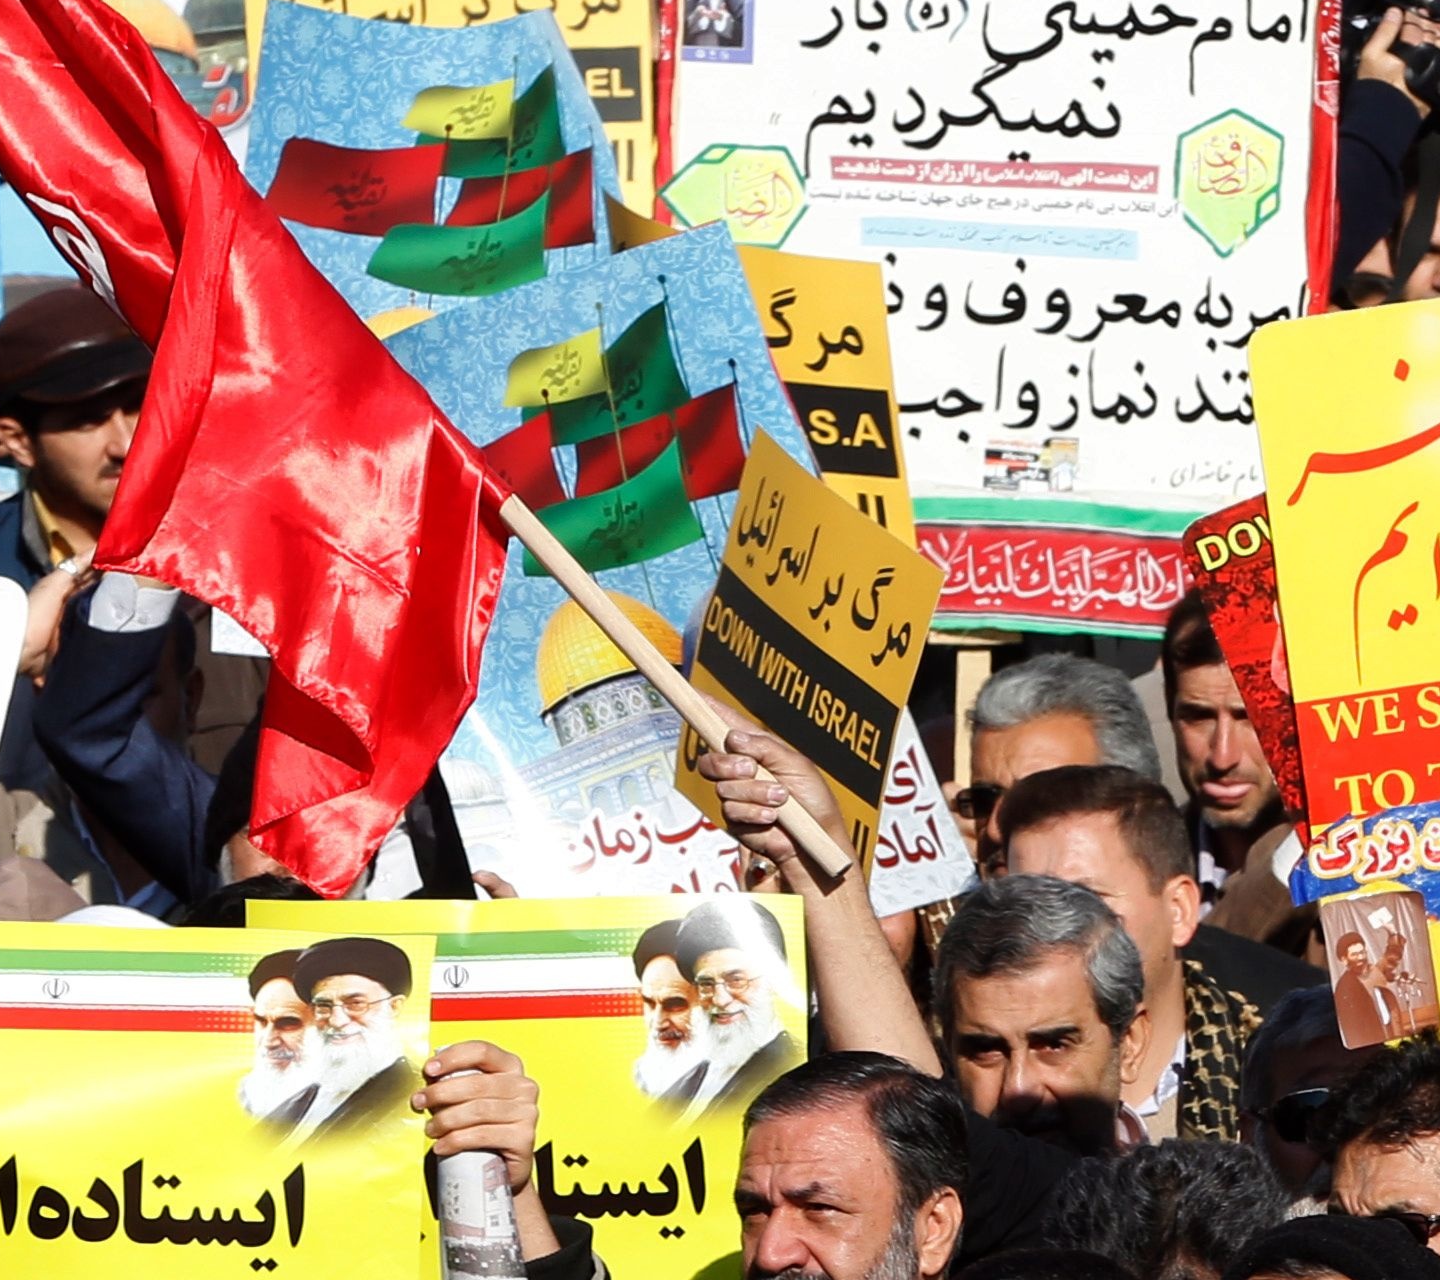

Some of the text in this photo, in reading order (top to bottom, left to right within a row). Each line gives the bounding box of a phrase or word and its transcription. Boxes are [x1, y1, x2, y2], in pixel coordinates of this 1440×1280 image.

[707, 599, 882, 769] DOWN WITH ISRAEL
[1312, 693, 1405, 742] WE
[1334, 769, 1415, 817] TO
[1314, 822, 1415, 878] بزرگ
